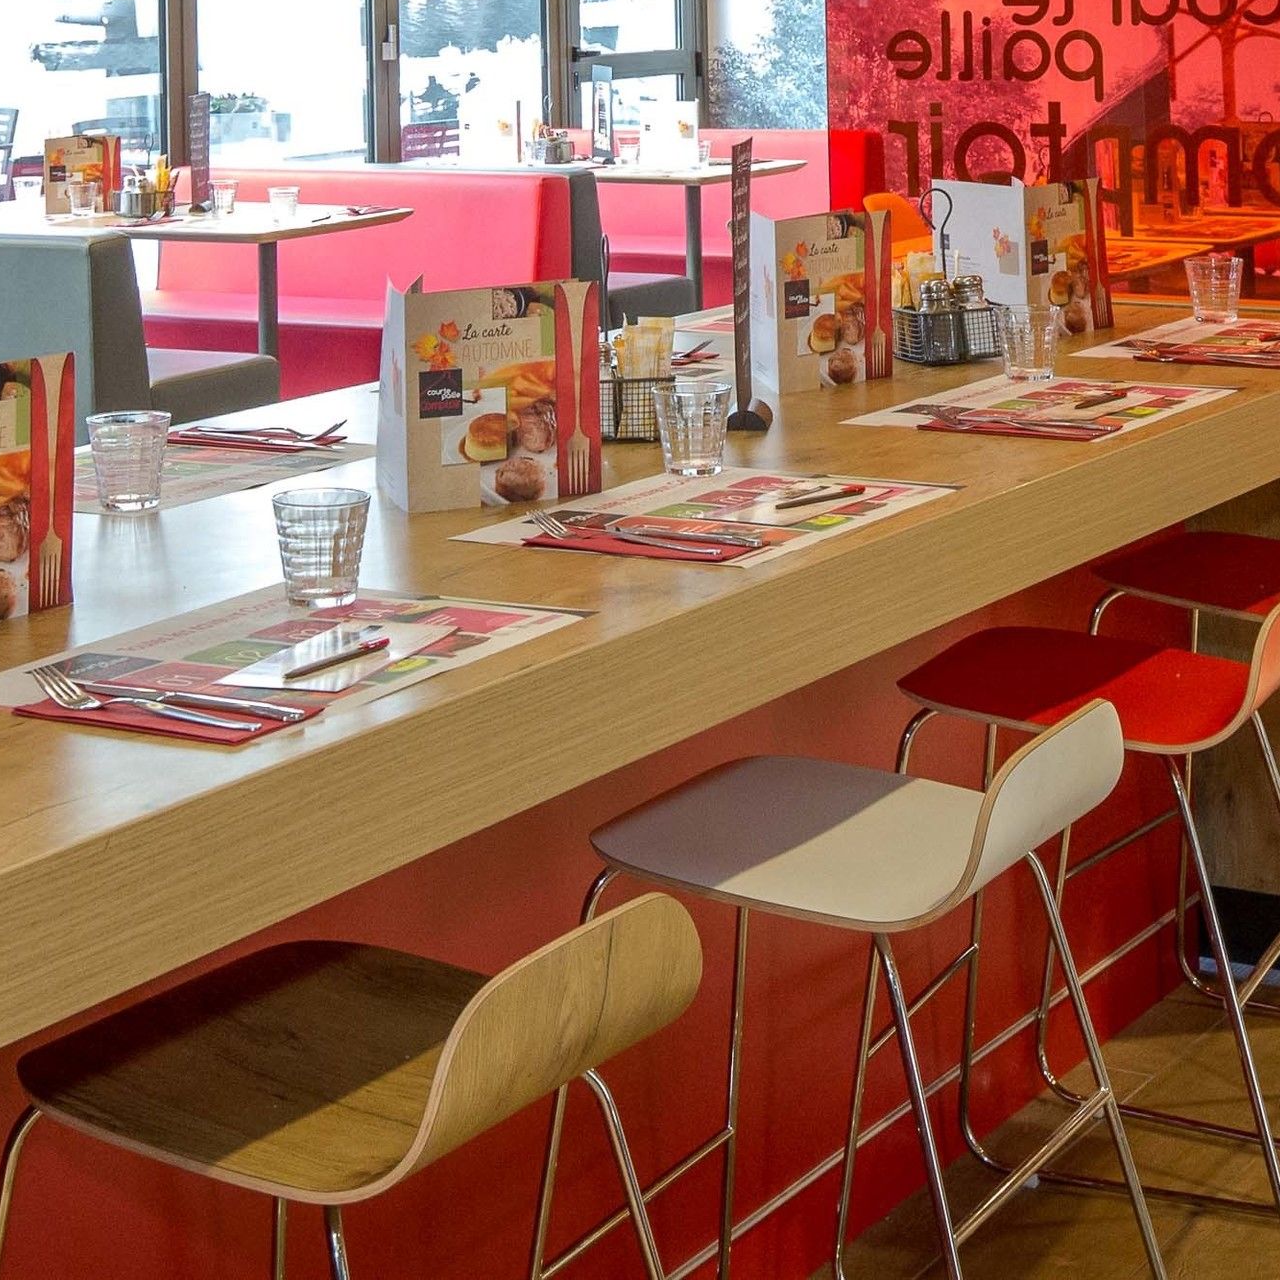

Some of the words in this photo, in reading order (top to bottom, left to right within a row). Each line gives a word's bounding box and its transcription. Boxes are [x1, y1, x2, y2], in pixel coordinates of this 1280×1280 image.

[462, 322, 480, 341] La
[481, 322, 513, 339] carte
[461, 338, 533, 364] AUTOMNE
